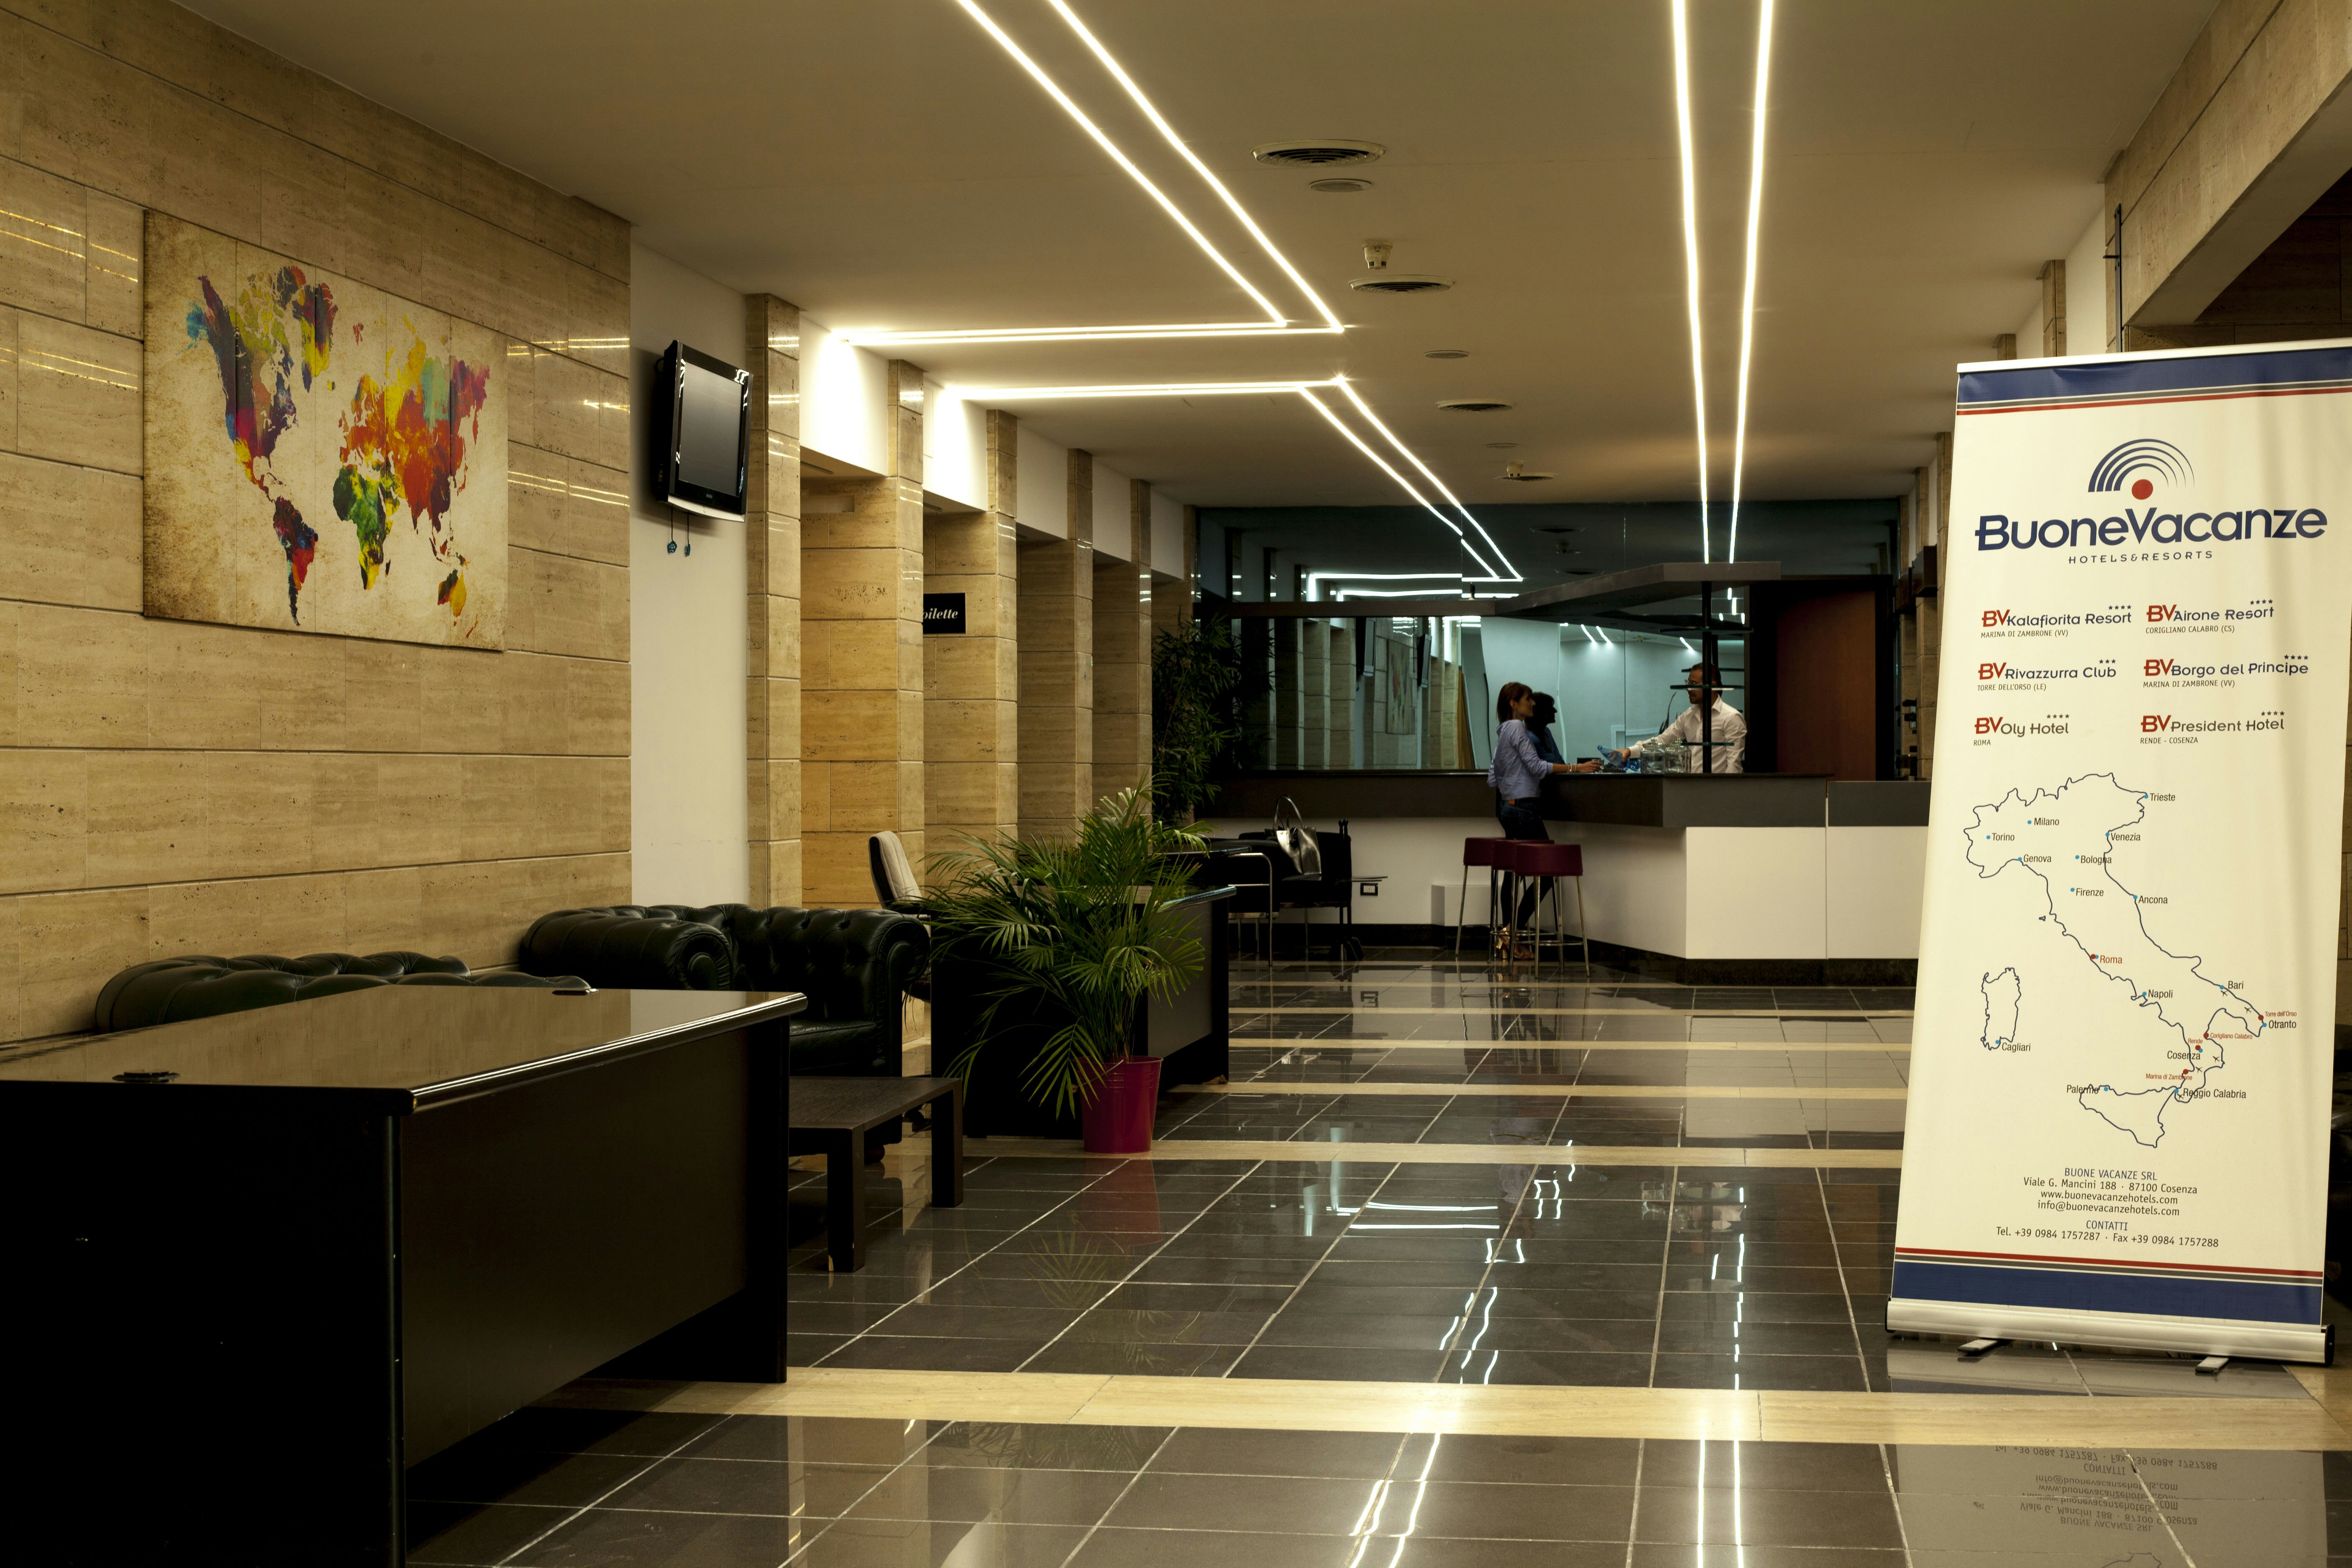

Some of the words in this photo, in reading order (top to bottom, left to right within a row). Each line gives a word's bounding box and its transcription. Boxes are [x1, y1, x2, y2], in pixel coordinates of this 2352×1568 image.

[1975, 507, 2328, 551] BuoneVacanze
[923, 608, 958, 619] oilette
[2085, 612, 2132, 624] Resort
[2224, 606, 2274, 620] Resort
[2083, 667, 2116, 678] Club
[2220, 664, 2244, 675] del
[2248, 662, 2308, 676] Principe
[2030, 722, 2069, 734] Hotel
[2246, 718, 2285, 731] Hotel
[2150, 793, 2175, 801] Trieste
[2034, 817, 2060, 826] Milano
[1992, 833, 2015, 841] Torino
[2081, 856, 2112, 865] Bologna
[2076, 887, 2104, 897] Firenze
[2100, 955, 2122, 964] Roma
[2148, 990, 2173, 1000] Napoli
[2269, 1020, 2297, 1029] Otranto
[2002, 1042, 2031, 1053] Cagliari
[2167, 1051, 2201, 1060] Cosenza
[2067, 1085, 2099, 1094] Palermo
[2183, 1089, 2211, 1099] Reggio
[2213, 1089, 2246, 1099] Calabria
[2065, 1168, 2095, 1178] BUONE
[2099, 1169, 2138, 1180] VACANZE
[2141, 1171, 2157, 1181] SRL
[2024, 1177, 2045, 1186] Viale
[2048, 1178, 2057, 1187] G.
[2061, 1179, 2096, 1189] Mancini
[2100, 1181, 2116, 1190] 188
[2129, 1182, 2157, 1192] 87100
[2161, 1184, 2197, 1194] Cosenza
[2041, 1190, 2178, 1205] www.buonevacanzehotels.com
[2037, 1201, 2179, 1216] info@buonevacanzehotels.com
[2086, 1220, 2128, 1231] CONTATTI
[1996, 1226, 2011, 1236] Tel.
[2015, 1228, 2032, 1237] +39
[2035, 1229, 2057, 1238] 0984
[2061, 1230, 2100, 1241] 1757287
[2113, 1233, 2128, 1243] Fax
[2131, 1234, 2148, 1243] +39
[2152, 1235, 2175, 1245] 0984
[2179, 1237, 2218, 1248] 1757288
